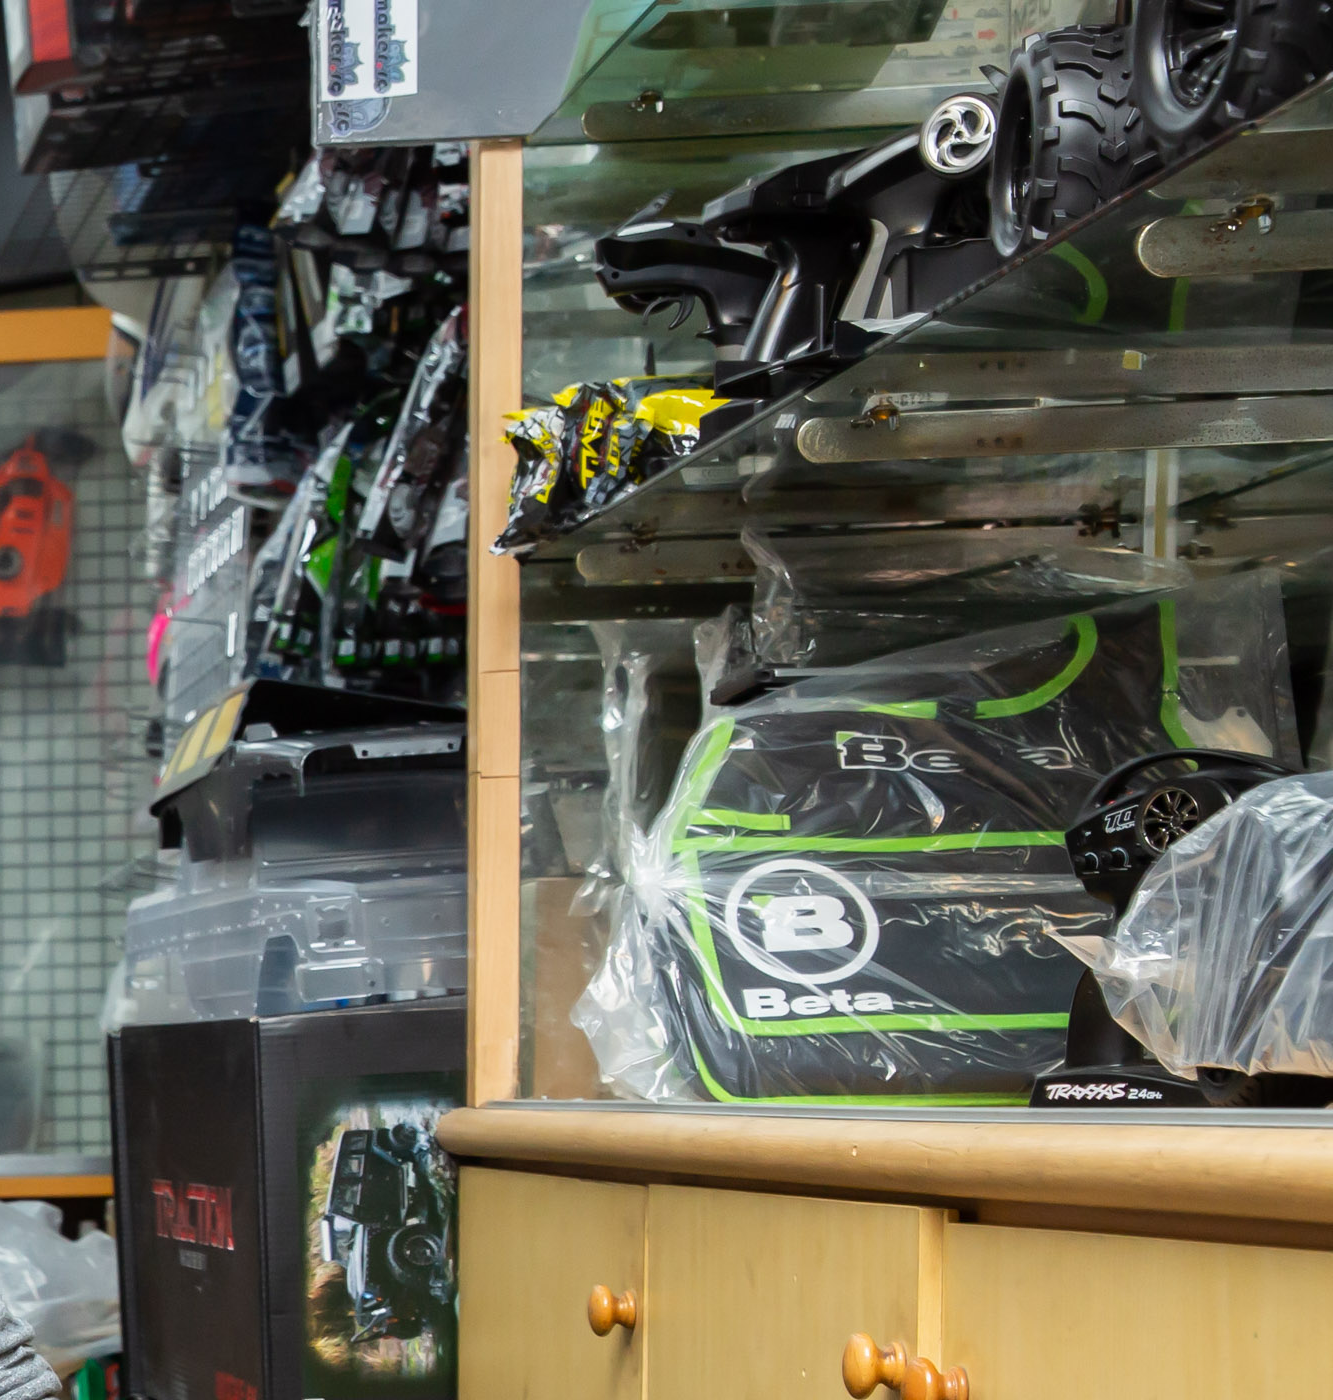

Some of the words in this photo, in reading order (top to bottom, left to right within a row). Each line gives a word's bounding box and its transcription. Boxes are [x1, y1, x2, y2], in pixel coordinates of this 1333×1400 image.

[835, 730, 1074, 773] Bea
[751, 895, 855, 953] B
[742, 986, 895, 1019] Beta
[1046, 1082, 1128, 1100] TRAXXAS
